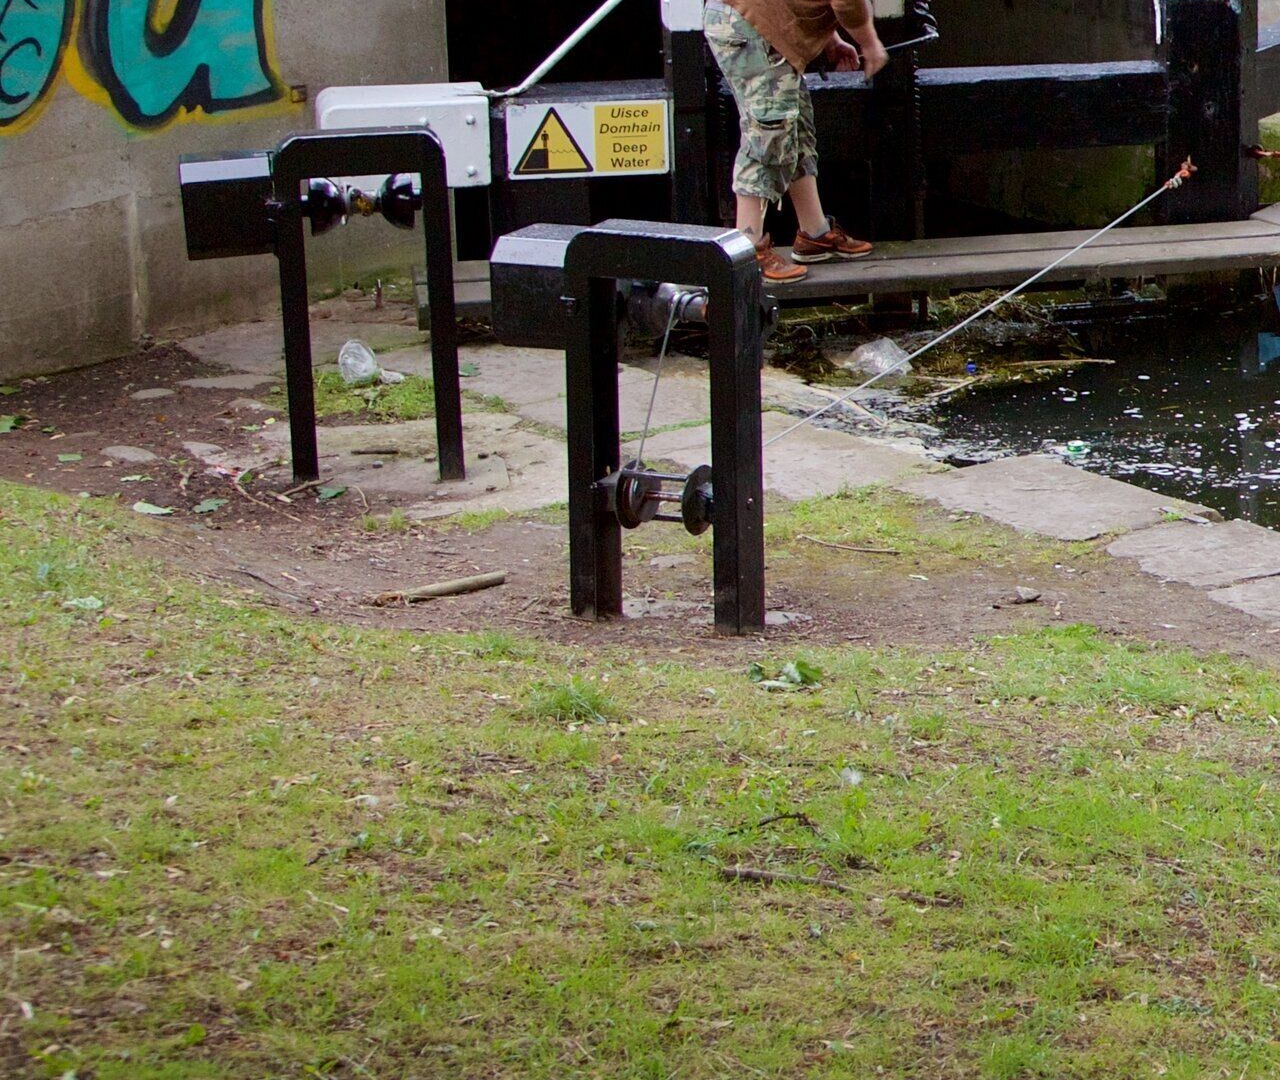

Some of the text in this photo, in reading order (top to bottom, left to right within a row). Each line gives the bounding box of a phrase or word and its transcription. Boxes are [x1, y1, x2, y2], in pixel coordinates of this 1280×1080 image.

[611, 107, 649, 118] Uisce
[599, 122, 661, 134] Domhain
[612, 142, 648, 155] Deep
[610, 157, 651, 168] Water
